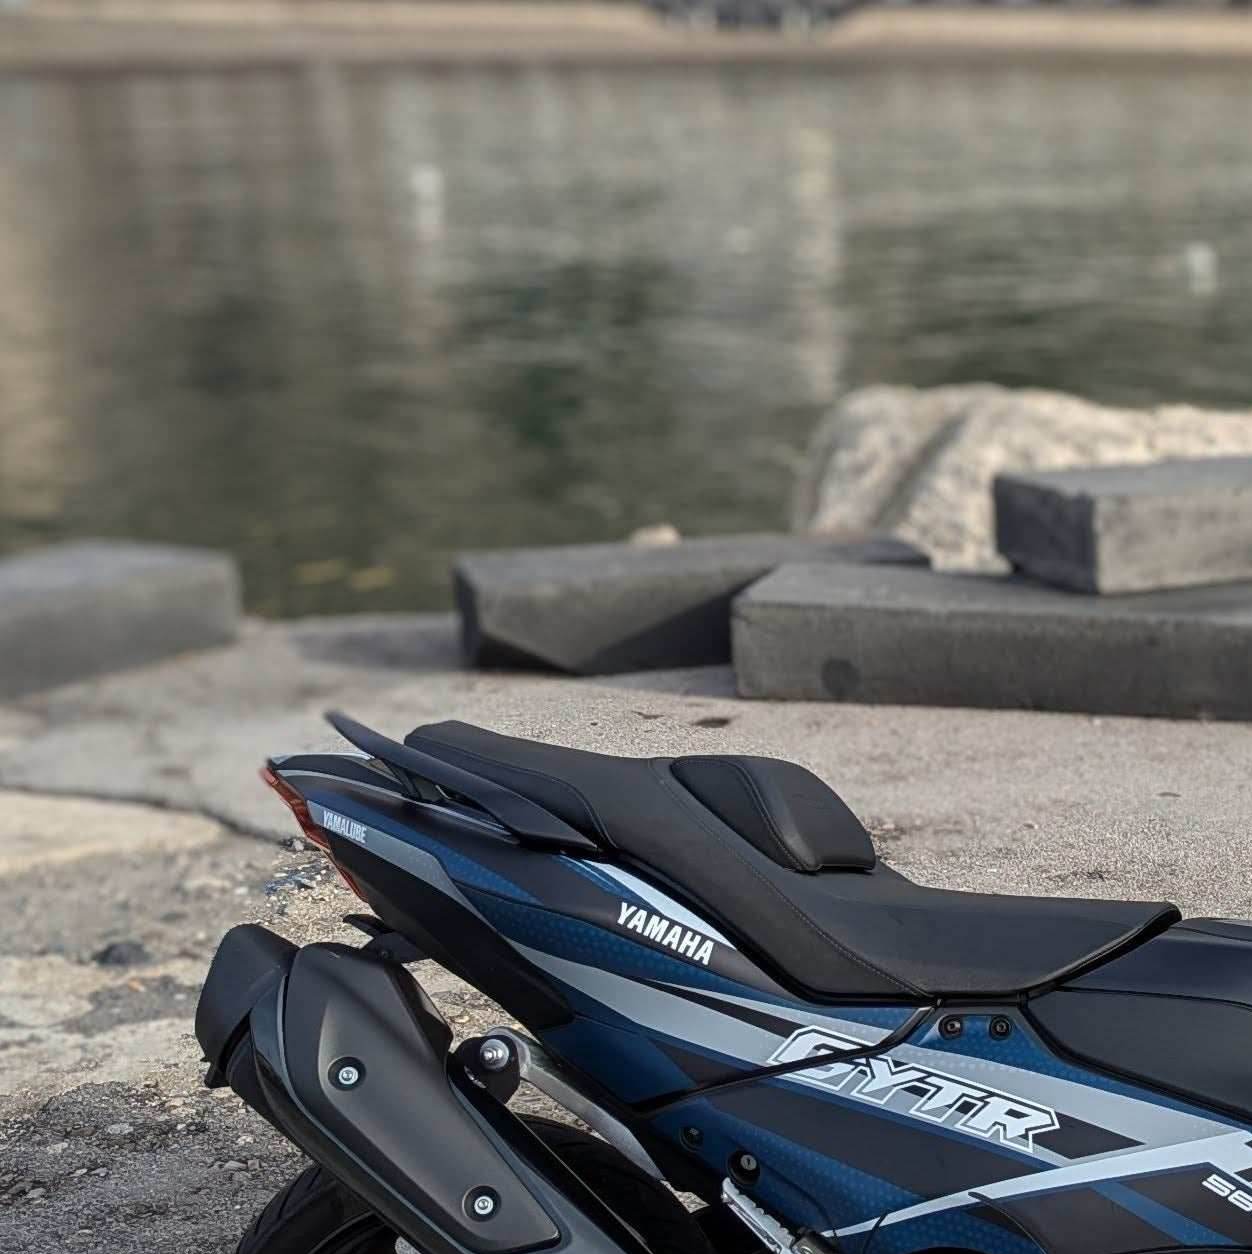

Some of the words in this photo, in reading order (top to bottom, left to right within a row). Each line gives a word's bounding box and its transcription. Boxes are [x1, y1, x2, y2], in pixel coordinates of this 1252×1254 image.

[323, 810, 367, 844] YAMALUBE
[617, 902, 714, 965] YAMAHA
[766, 1025, 1060, 1153] GYTR
